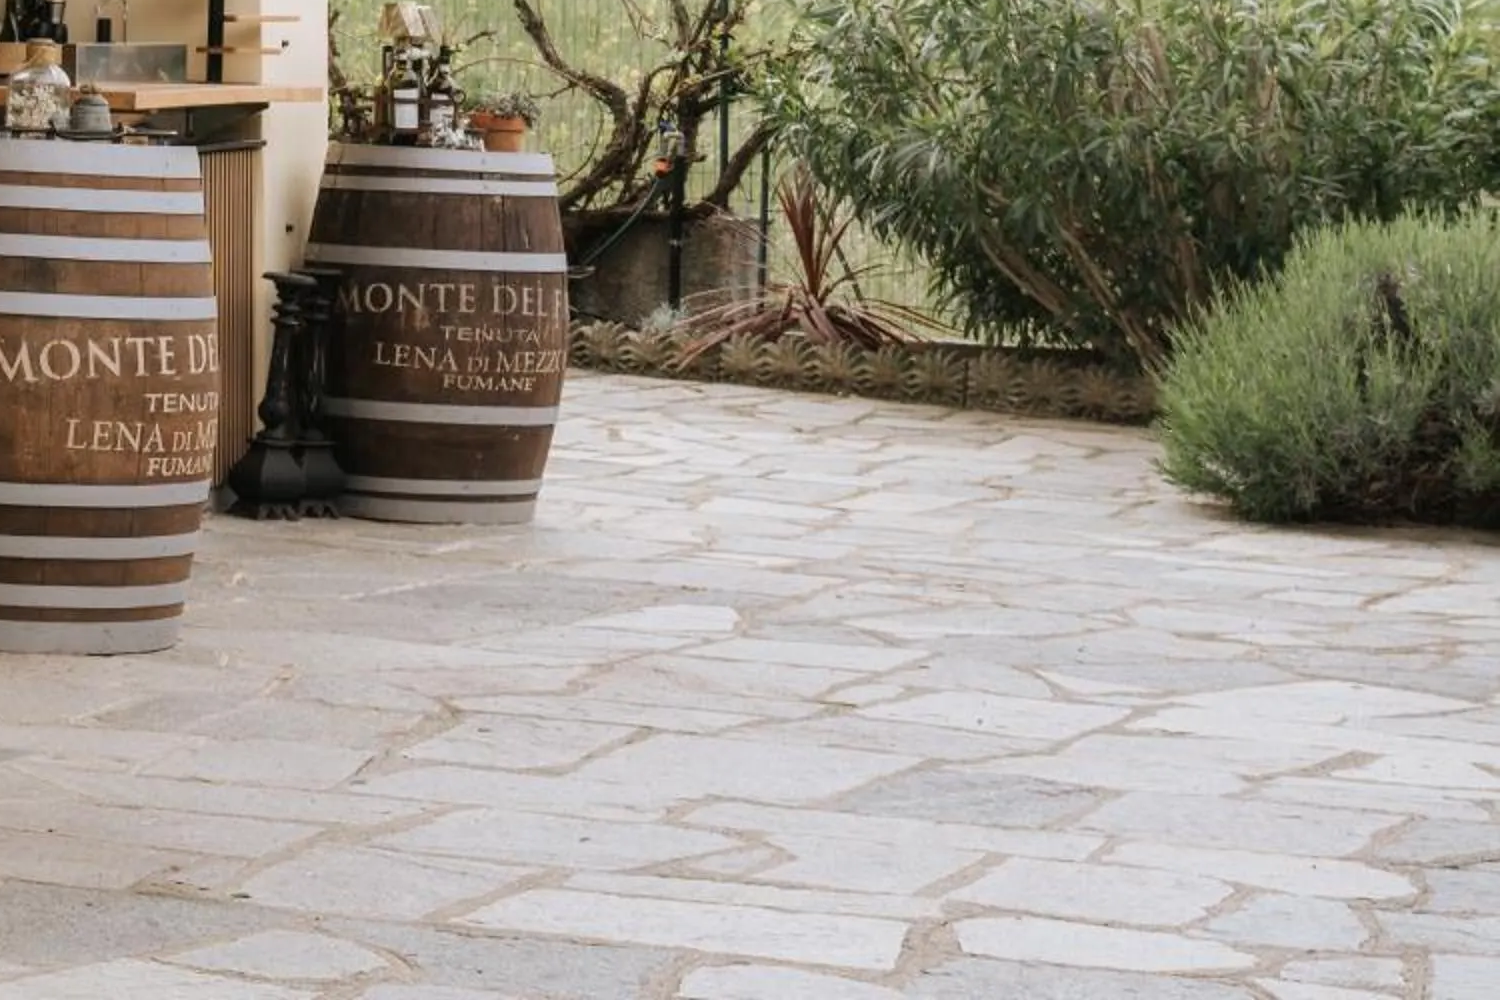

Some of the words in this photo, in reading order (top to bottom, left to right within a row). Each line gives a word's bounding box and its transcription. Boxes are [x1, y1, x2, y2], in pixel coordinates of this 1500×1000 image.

[336, 282, 477, 314] MONTE
[491, 284, 549, 317] DEL
[440, 325, 541, 346] TENUTA
[373, 341, 458, 373] LENA
[467, 356, 489, 374] DI
[443, 374, 536, 392] FUMANE
[66, 418, 166, 453] LENA
[171, 430, 194, 453] DI
